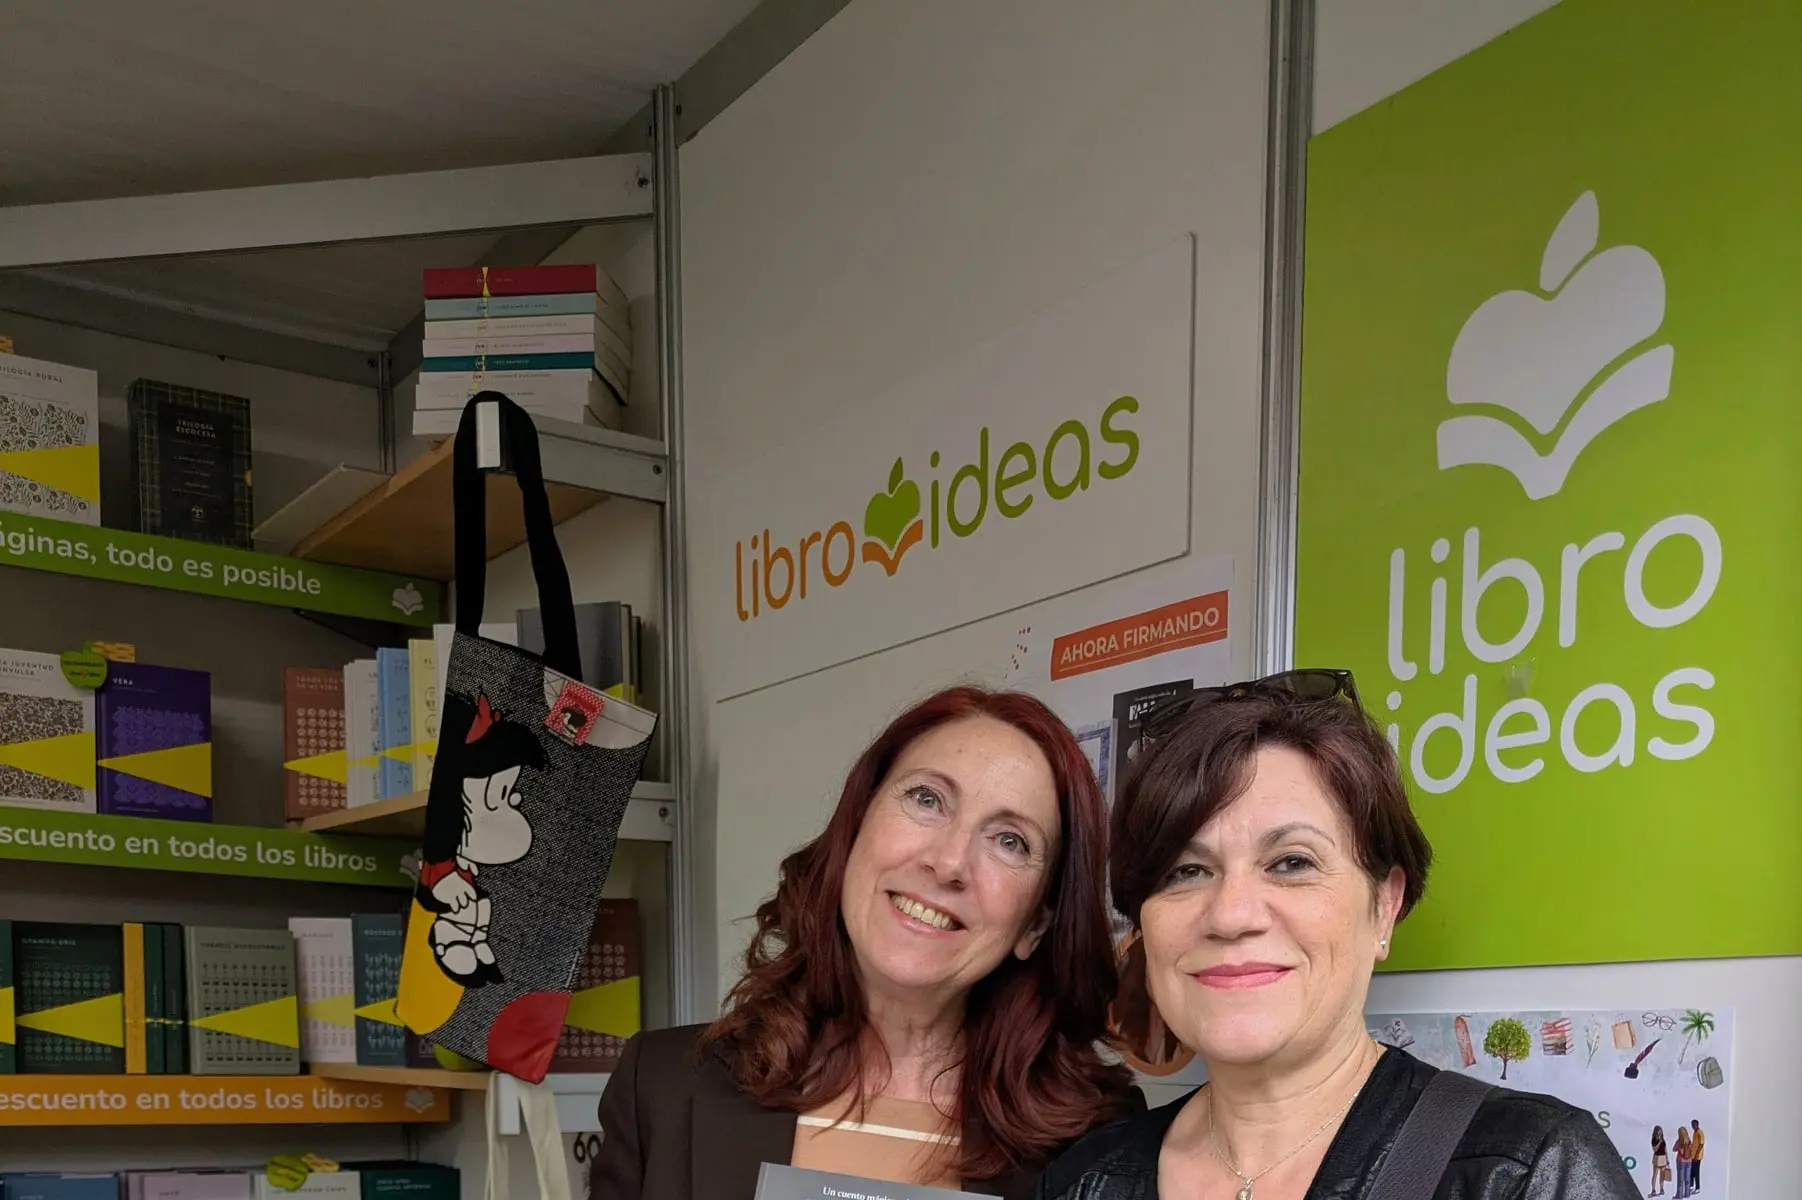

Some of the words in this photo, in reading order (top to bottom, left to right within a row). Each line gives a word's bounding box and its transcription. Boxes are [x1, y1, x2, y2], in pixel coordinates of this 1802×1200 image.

[735, 521, 856, 622] libro
[929, 396, 1141, 549] ideas
[107, 543, 174, 573] todo
[183, 558, 214, 579] es
[223, 564, 322, 596] posible
[1388, 513, 1723, 681] libro
[1060, 633, 1119, 665] AHORA
[1123, 607, 1220, 648] FIRMANDO
[112, 678, 134, 686] VERA
[1386, 667, 1716, 794] ideas
[0, 825, 116, 853] scuento
[125, 837, 159, 856] en
[168, 836, 248, 863] todos
[256, 842, 297, 867] los
[304, 847, 378, 873] libros
[0, 1088, 127, 1111] escuento
[140, 1093, 172, 1110] en
[178, 1088, 257, 1110] todos
[265, 1087, 305, 1110] los
[311, 1087, 384, 1110] libros
[822, 1186, 837, 1197] Un
